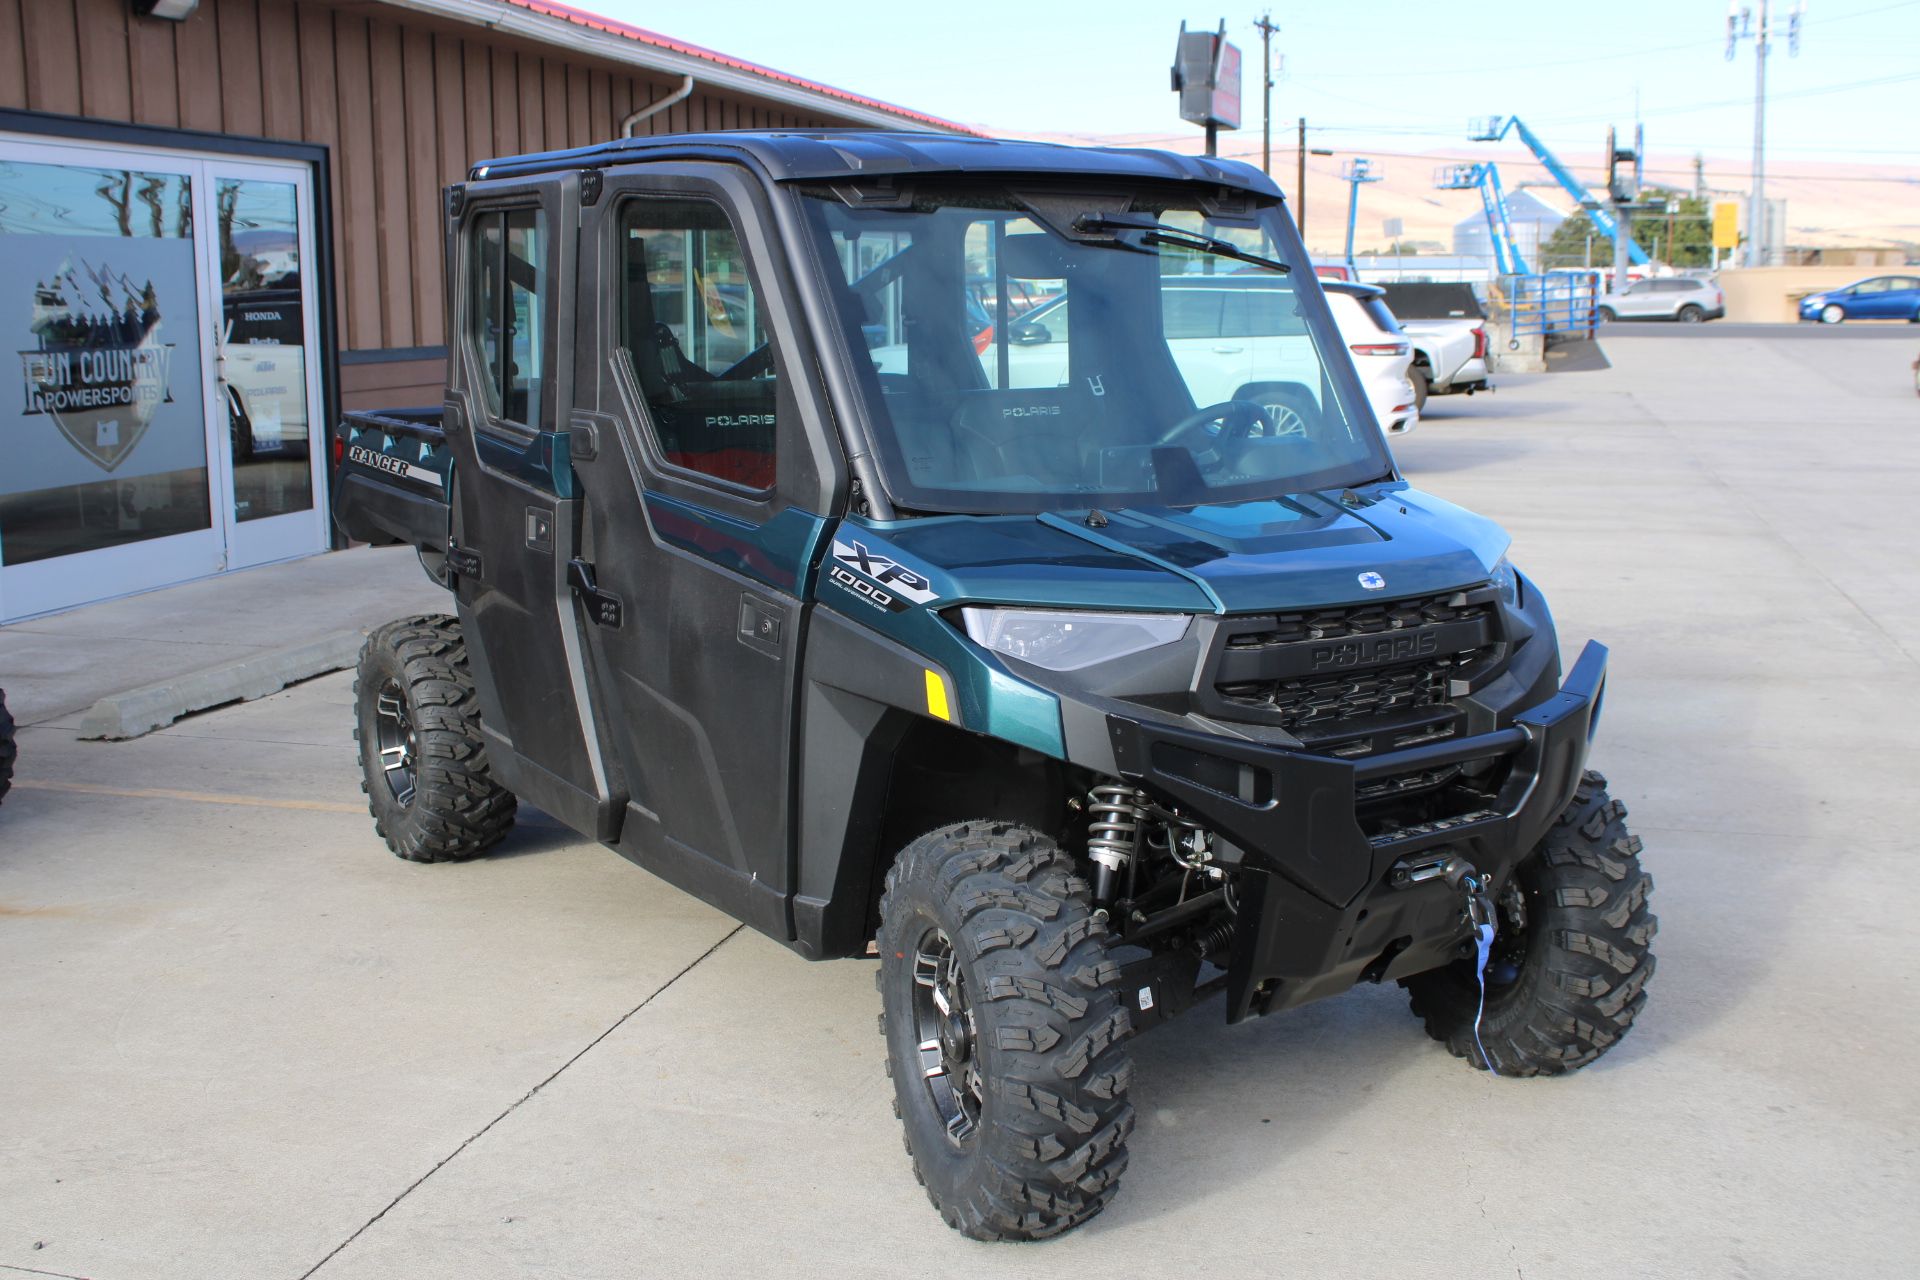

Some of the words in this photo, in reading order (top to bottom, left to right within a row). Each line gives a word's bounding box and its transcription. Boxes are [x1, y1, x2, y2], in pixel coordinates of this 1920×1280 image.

[244, 311, 282, 321] HONDA
[17, 351, 73, 415] FUN
[79, 344, 176, 402] COUNTRY
[705, 414, 776, 428] POLARIS
[1002, 406, 1061, 420] POLARIS
[349, 445, 409, 478] RANGER
[833, 540, 930, 592] XP
[829, 565, 893, 606] 1000
[1311, 632, 1438, 671] POLARIS
